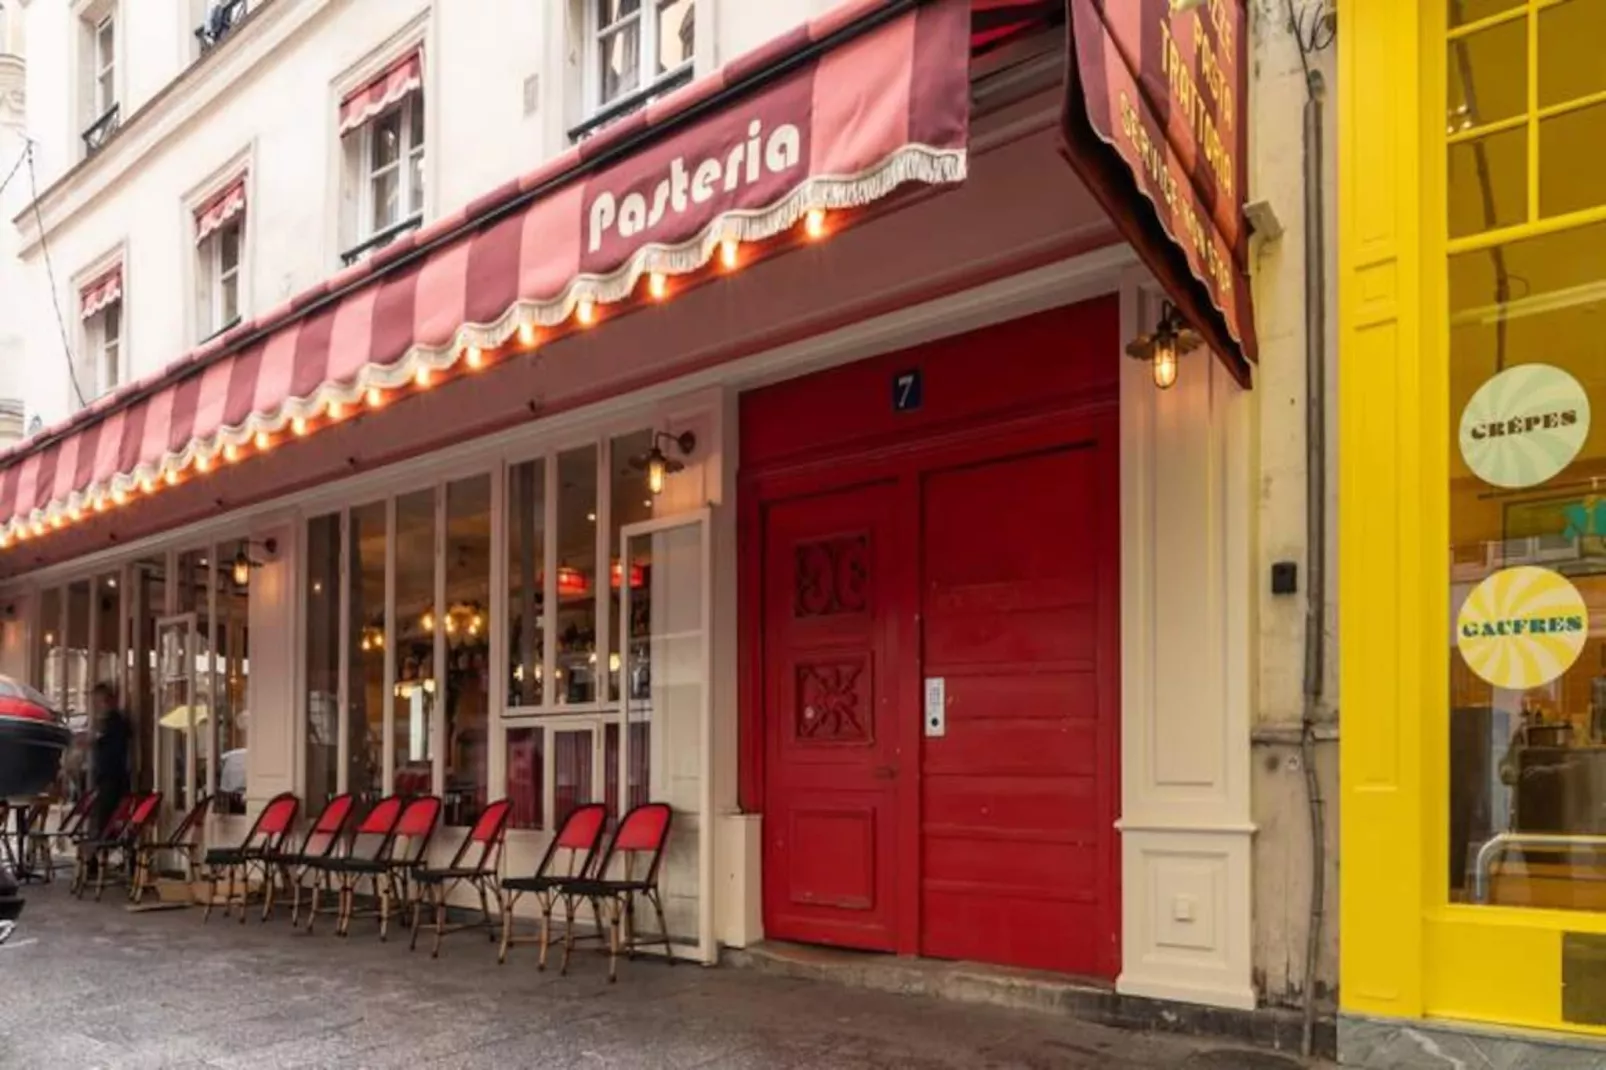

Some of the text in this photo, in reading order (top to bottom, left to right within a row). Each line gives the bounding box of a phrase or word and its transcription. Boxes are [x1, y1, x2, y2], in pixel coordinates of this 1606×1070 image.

[1193, 12, 1231, 131] PASTA
[588, 120, 800, 254] Pasteria
[898, 374, 914, 408] 7
[1470, 409, 1578, 440] CRÊPES
[1462, 615, 1583, 638] GAUFRES
